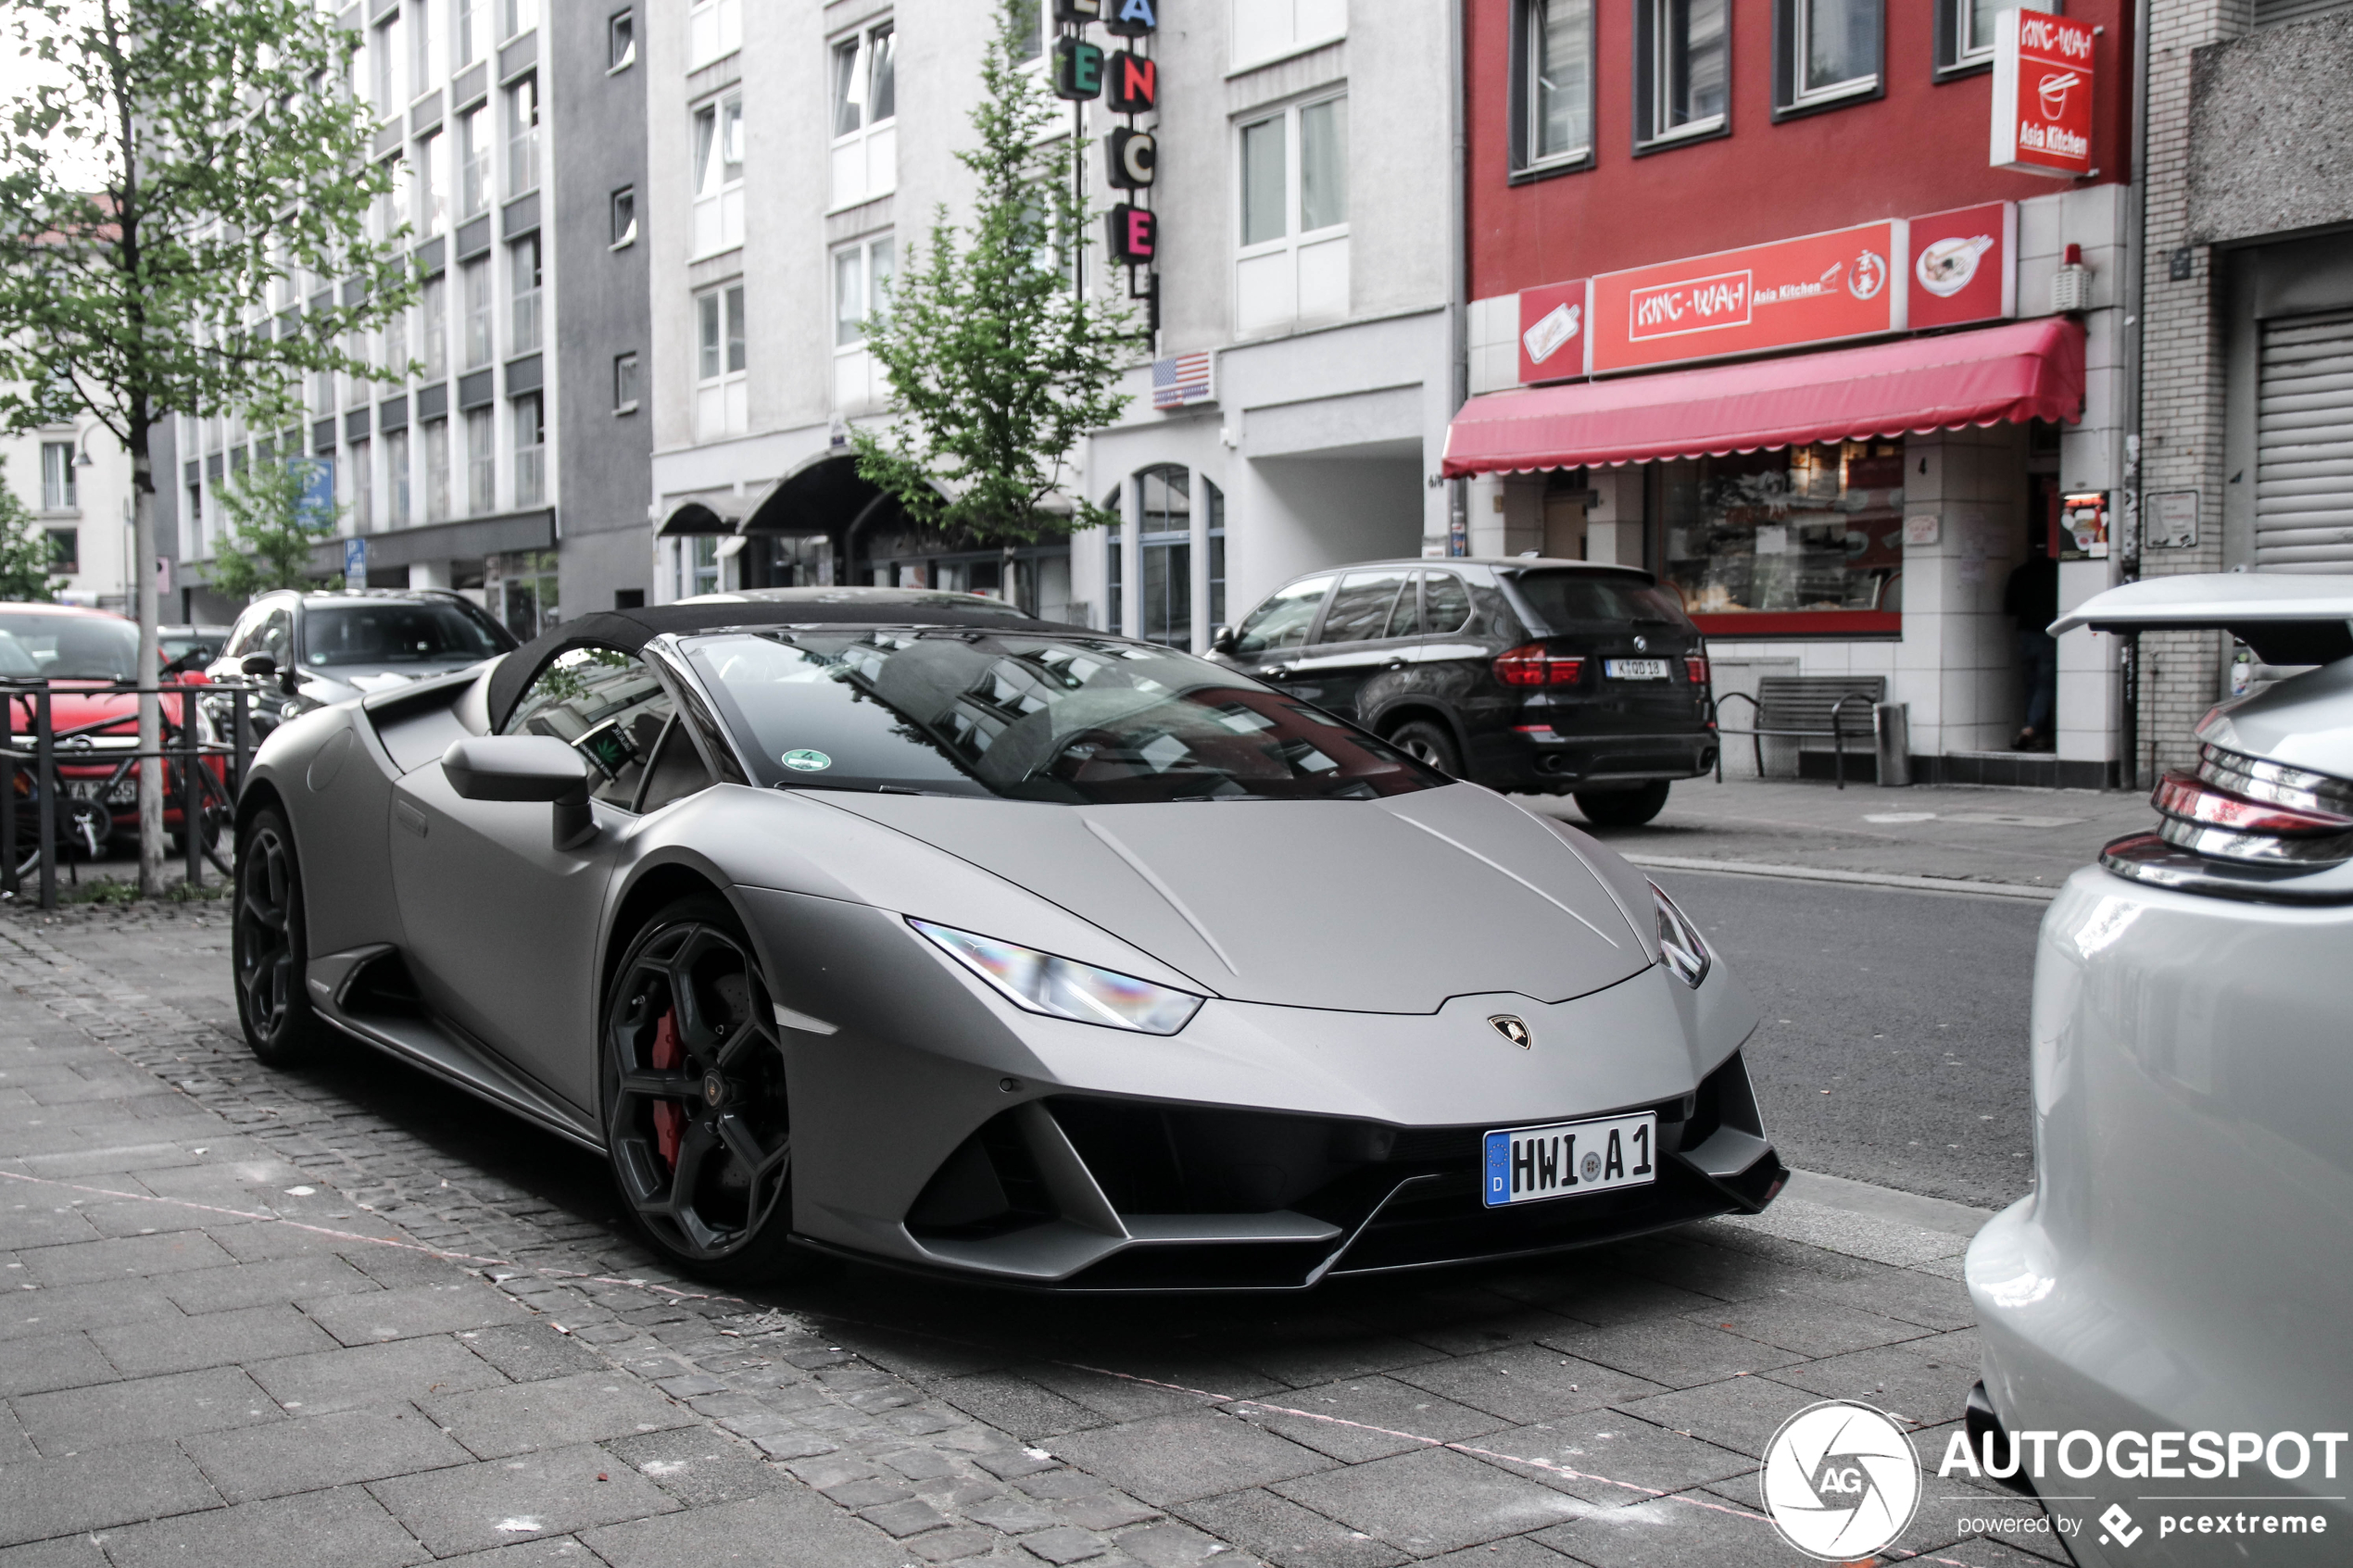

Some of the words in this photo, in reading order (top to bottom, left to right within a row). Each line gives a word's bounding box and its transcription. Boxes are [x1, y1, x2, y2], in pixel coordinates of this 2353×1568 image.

[2020, 120, 2045, 147] Asia
[2046, 125, 2088, 155] Kitchen
[1754, 290, 1777, 303] Asia
[1780, 282, 1821, 298] Kitchen
[1918, 457, 1926, 474] 4
[346, 541, 358, 557] P
[1617, 660, 1625, 674] K
[1647, 660, 1659, 674] 18
[1493, 1177, 1503, 1192] D
[1512, 1135, 1578, 1193] HWI
